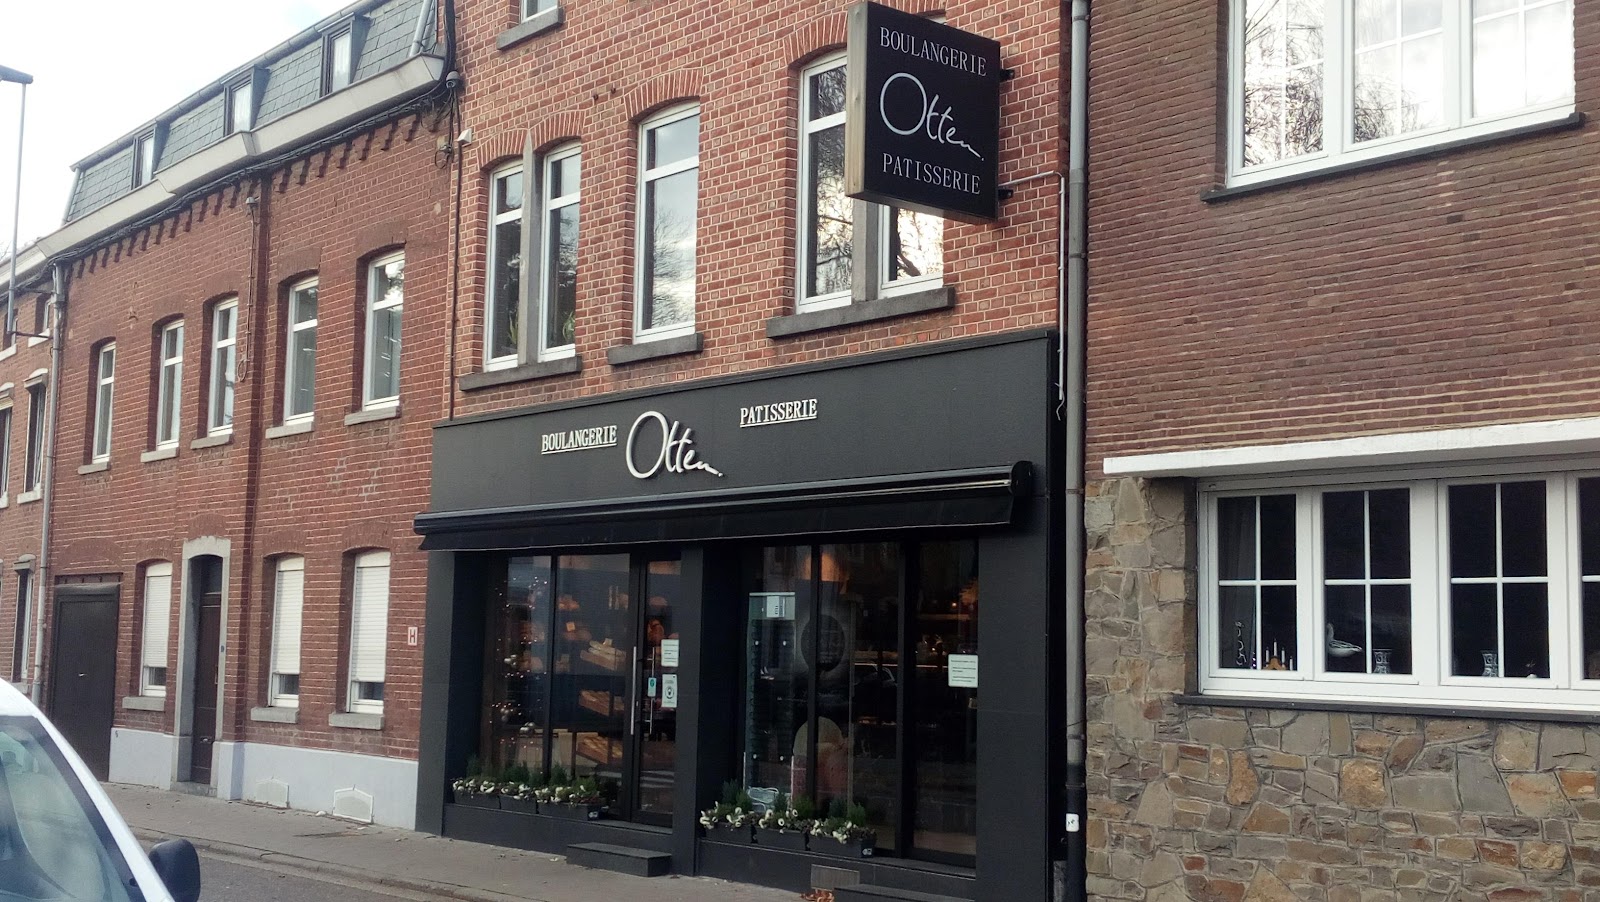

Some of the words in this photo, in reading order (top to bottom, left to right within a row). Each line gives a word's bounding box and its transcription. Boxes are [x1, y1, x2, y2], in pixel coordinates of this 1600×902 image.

[880, 26, 987, 76] BOULANGERIE
[882, 153, 981, 195] PATISSERIE
[740, 399, 817, 426] PATISSERIE
[541, 425, 617, 453] BOULANGERIE
[409, 628, 416, 644] H
